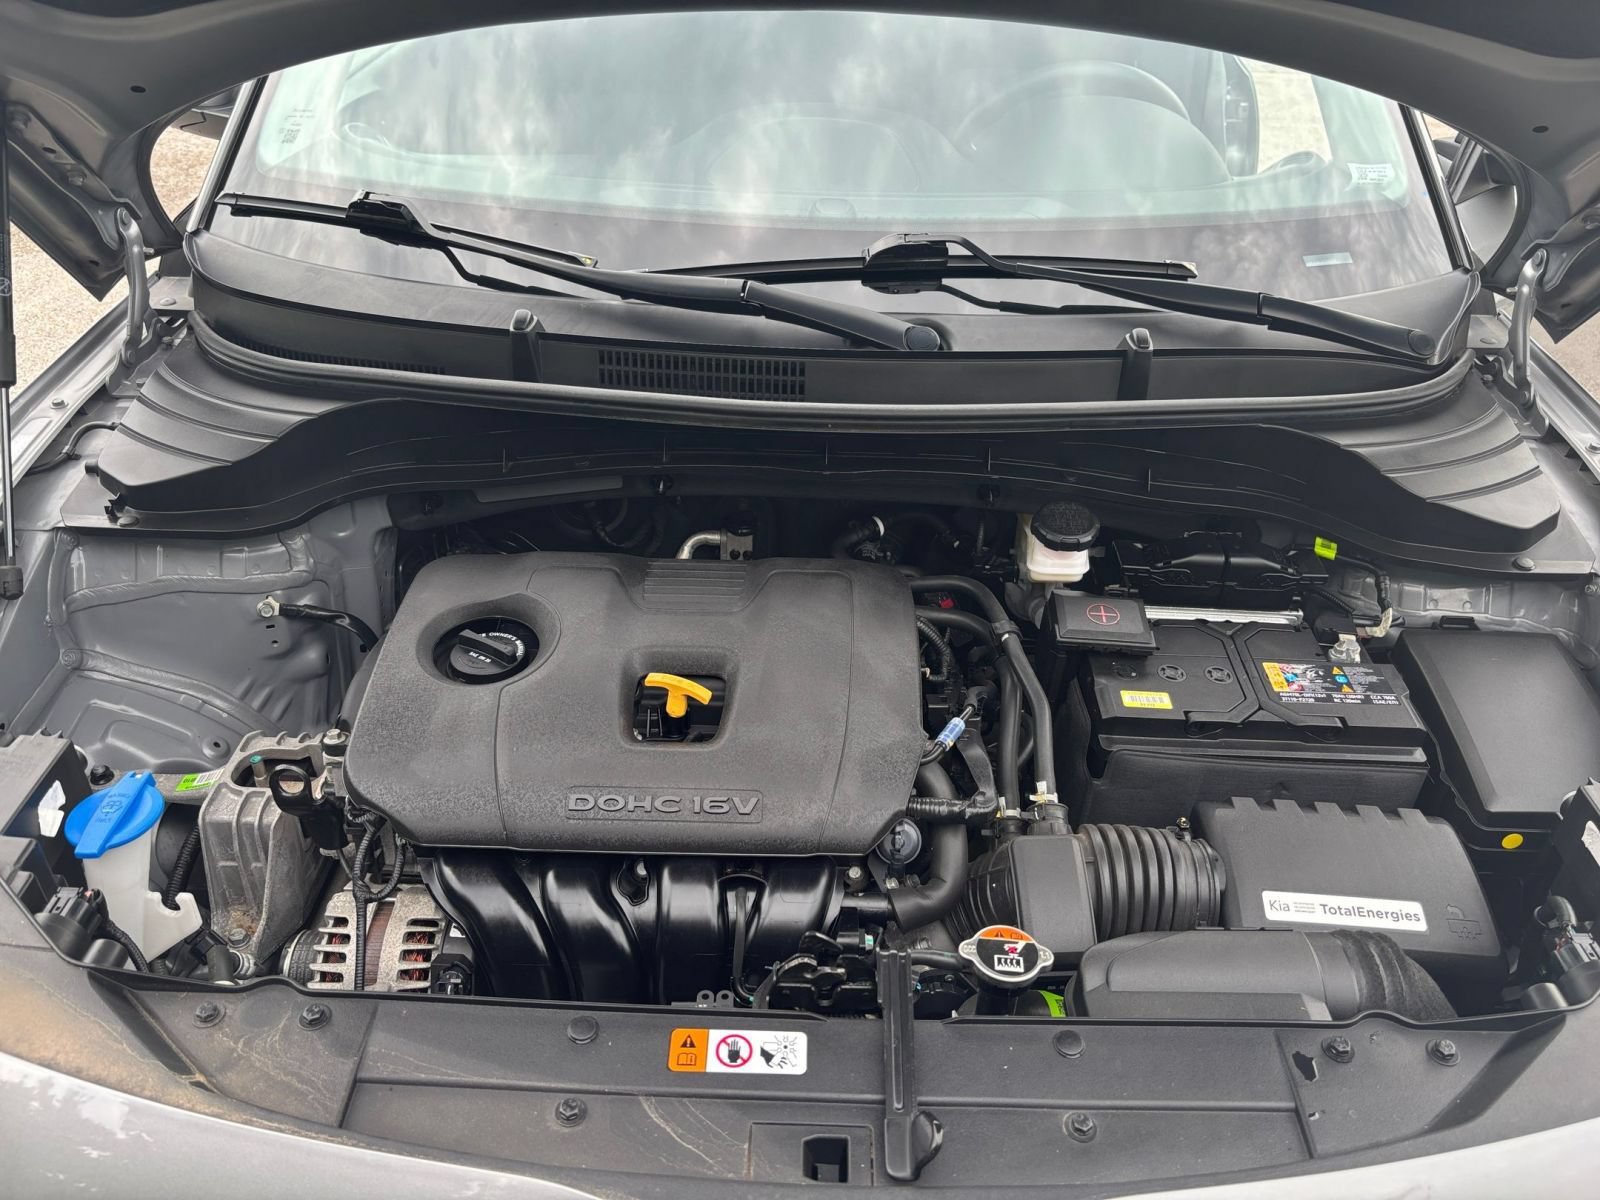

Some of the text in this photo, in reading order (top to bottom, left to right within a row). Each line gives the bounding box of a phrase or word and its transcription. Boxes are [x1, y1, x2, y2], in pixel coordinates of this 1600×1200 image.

[568, 794, 759, 815] DOHC 16V
[1268, 899, 1290, 913] Kia
[1319, 903, 1421, 922] TotalEnergies
